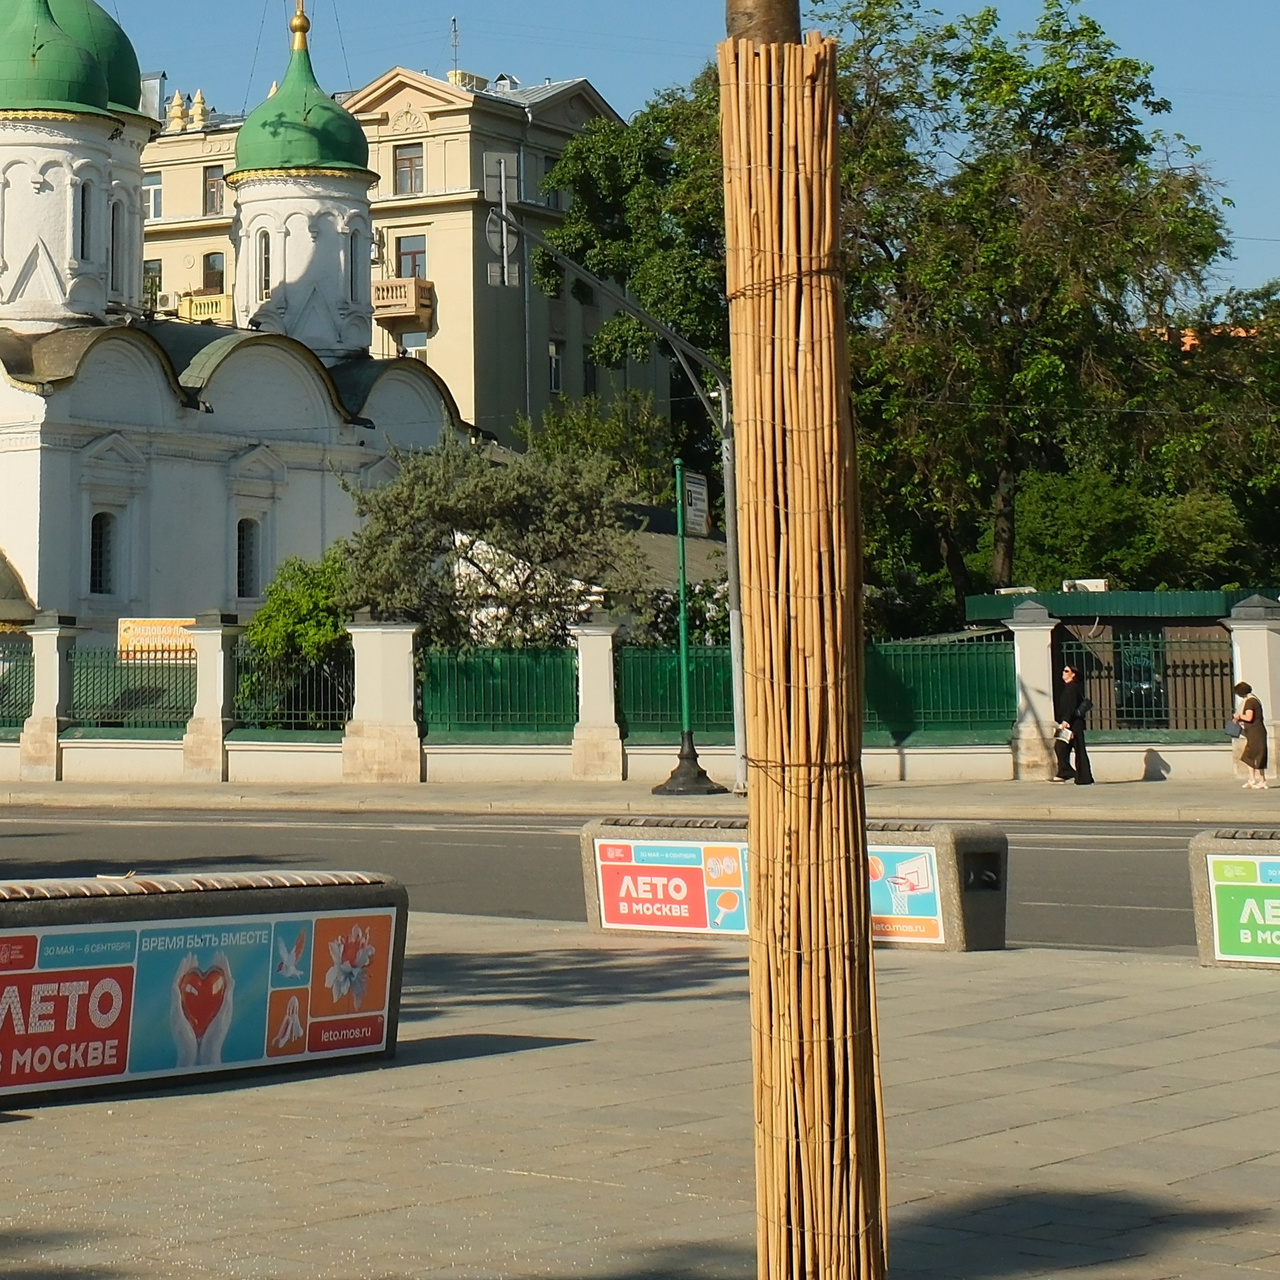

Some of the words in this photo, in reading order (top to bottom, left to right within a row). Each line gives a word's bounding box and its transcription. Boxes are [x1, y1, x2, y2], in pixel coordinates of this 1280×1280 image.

[619, 875, 688, 901] ЛЕТО
[619, 902, 629, 914] В
[632, 903, 690, 917] МОСКВЕ
[872, 922, 926, 932] leto.mos.ru
[141, 936, 184, 951] ВРЕМЯ
[186, 934, 219, 948] БЫТЬ
[220, 930, 269, 946] ВМЕСТЕ
[1240, 929, 1252, 943] В
[43, 946, 55, 956] 30
[55, 945, 75, 955] МАЯ
[84, 945, 90, 953] 6
[91, 941, 131, 953] СЕНТЯБРЯ
[321, 1027, 372, 1042] leto.mos.ru
[10, 1039, 119, 1075] МОСКВЕ
